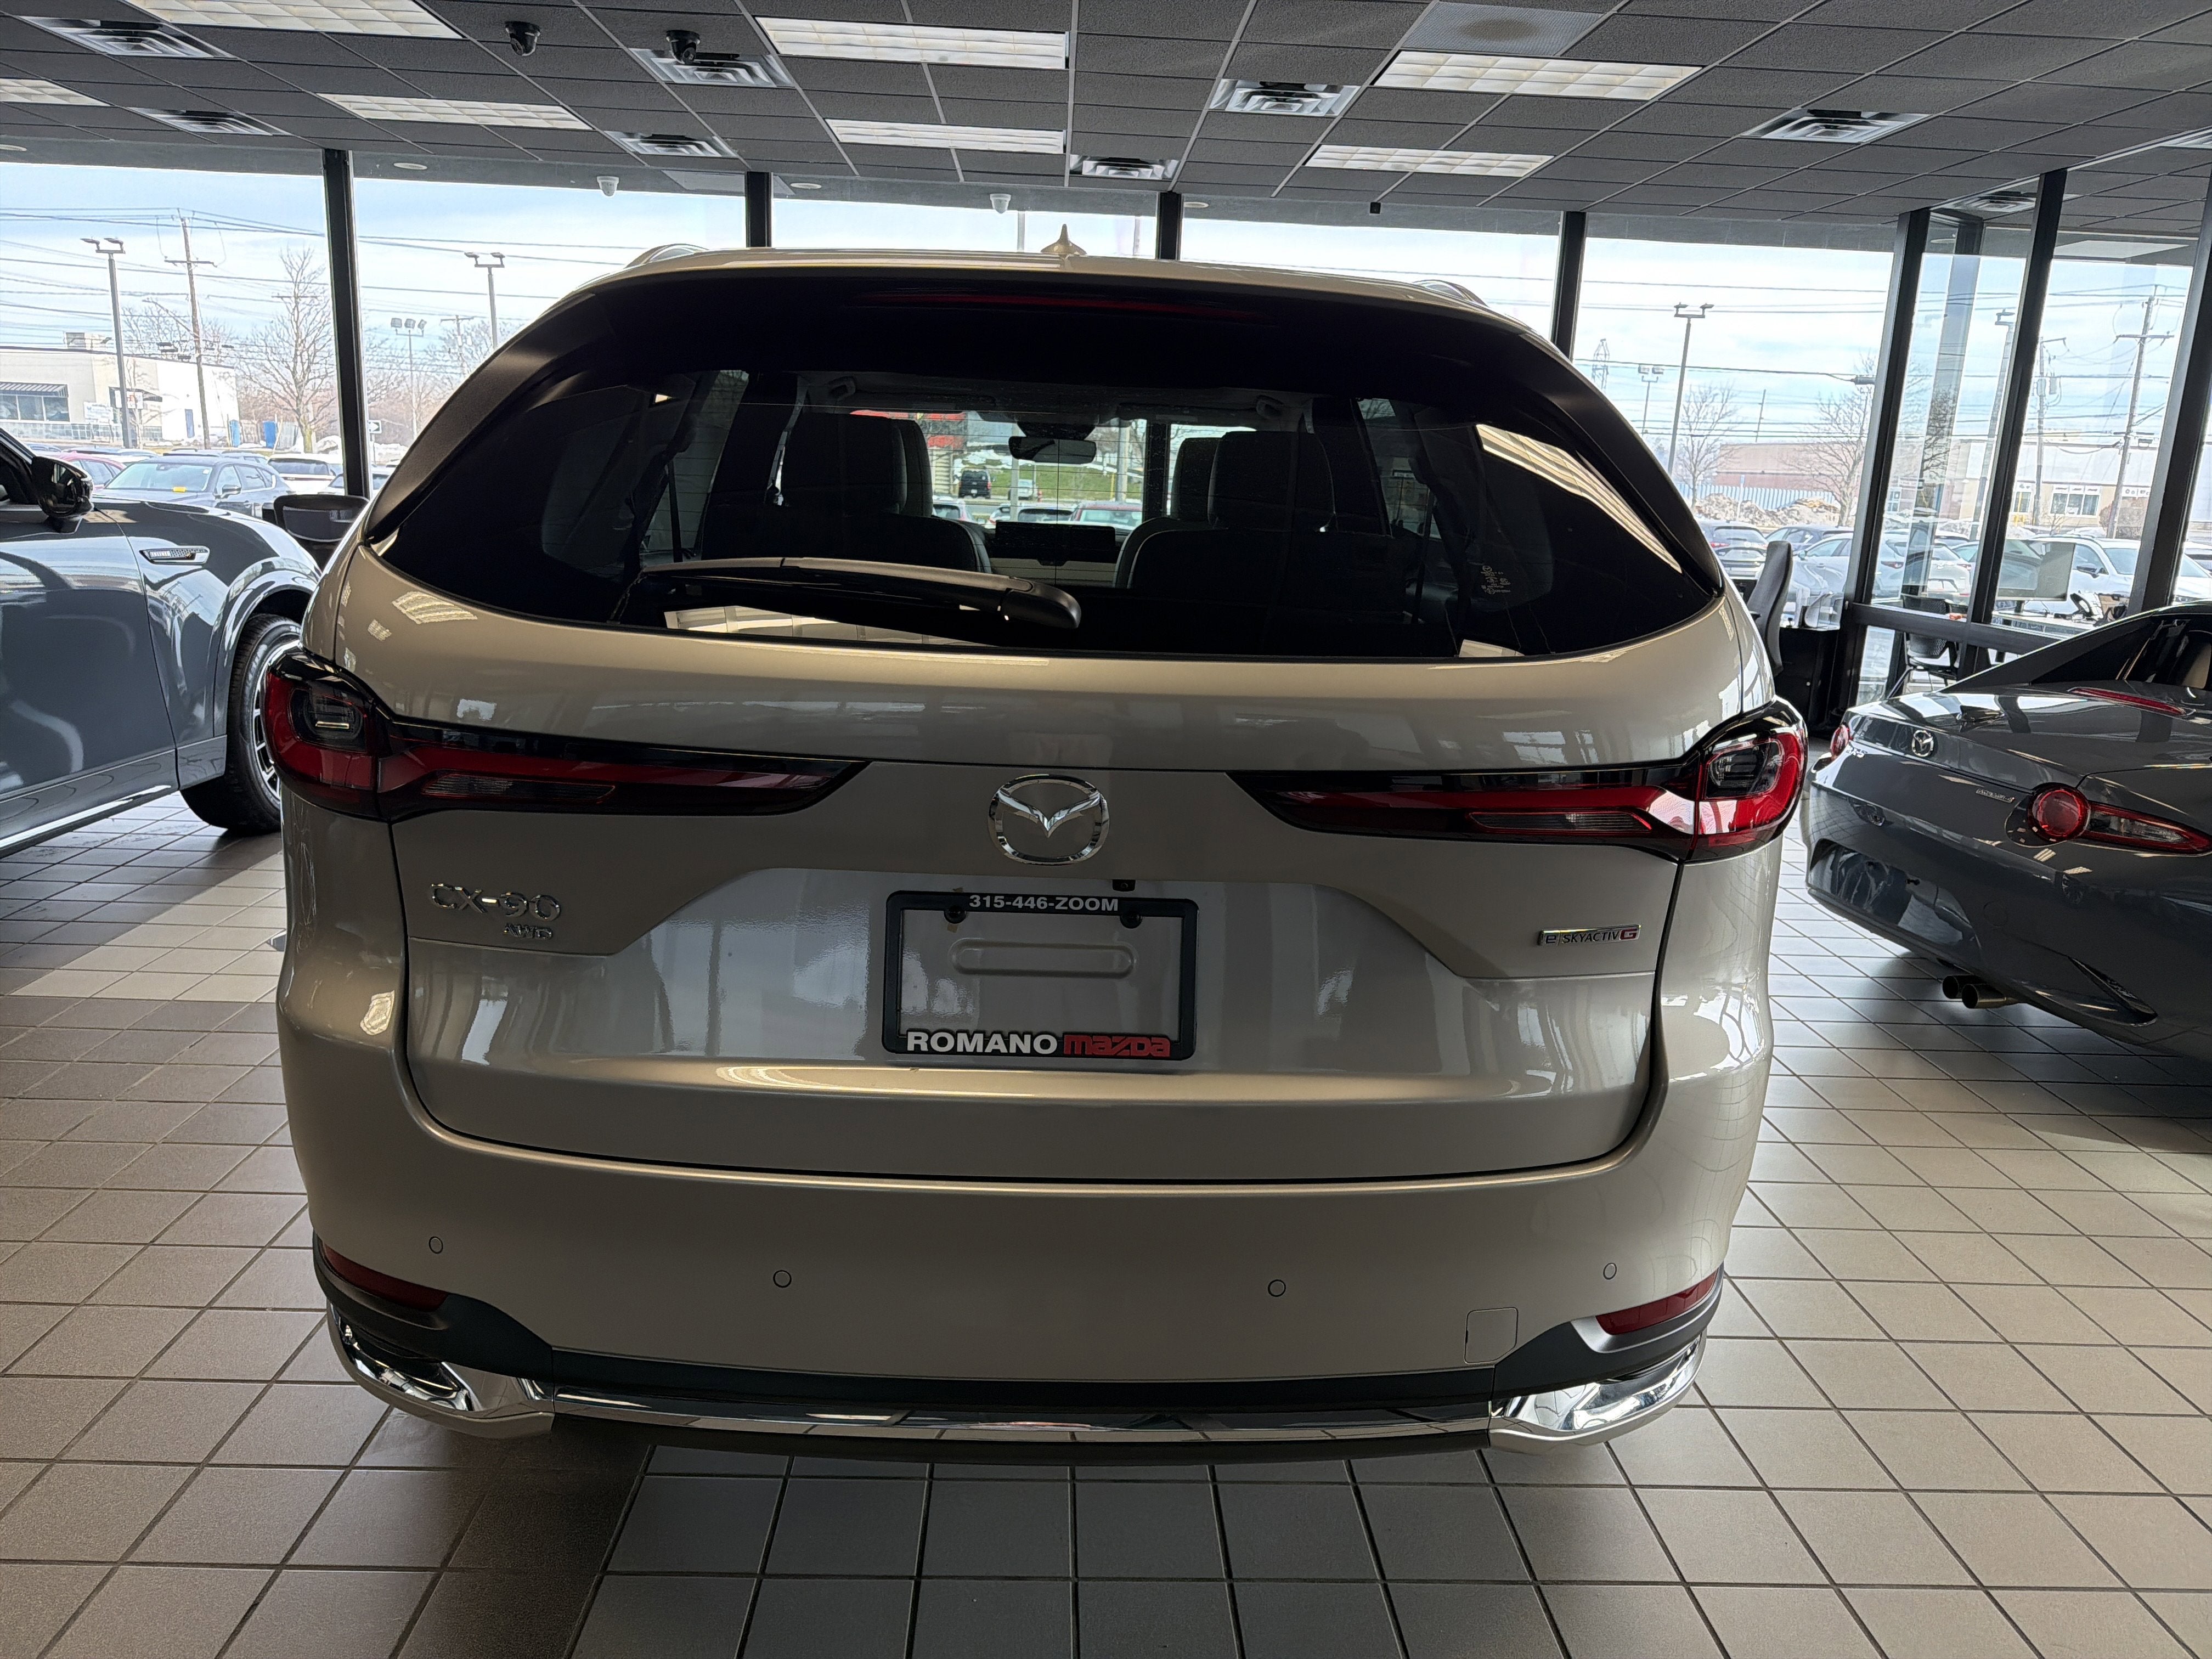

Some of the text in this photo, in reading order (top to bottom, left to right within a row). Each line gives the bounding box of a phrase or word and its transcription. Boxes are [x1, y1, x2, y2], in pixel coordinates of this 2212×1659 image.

[430, 883, 561, 921] CX-90
[969, 895, 1119, 911] 315-446-ZOOM
[503, 923, 554, 940] AWD
[907, 1031, 1058, 1054] ROMANO
